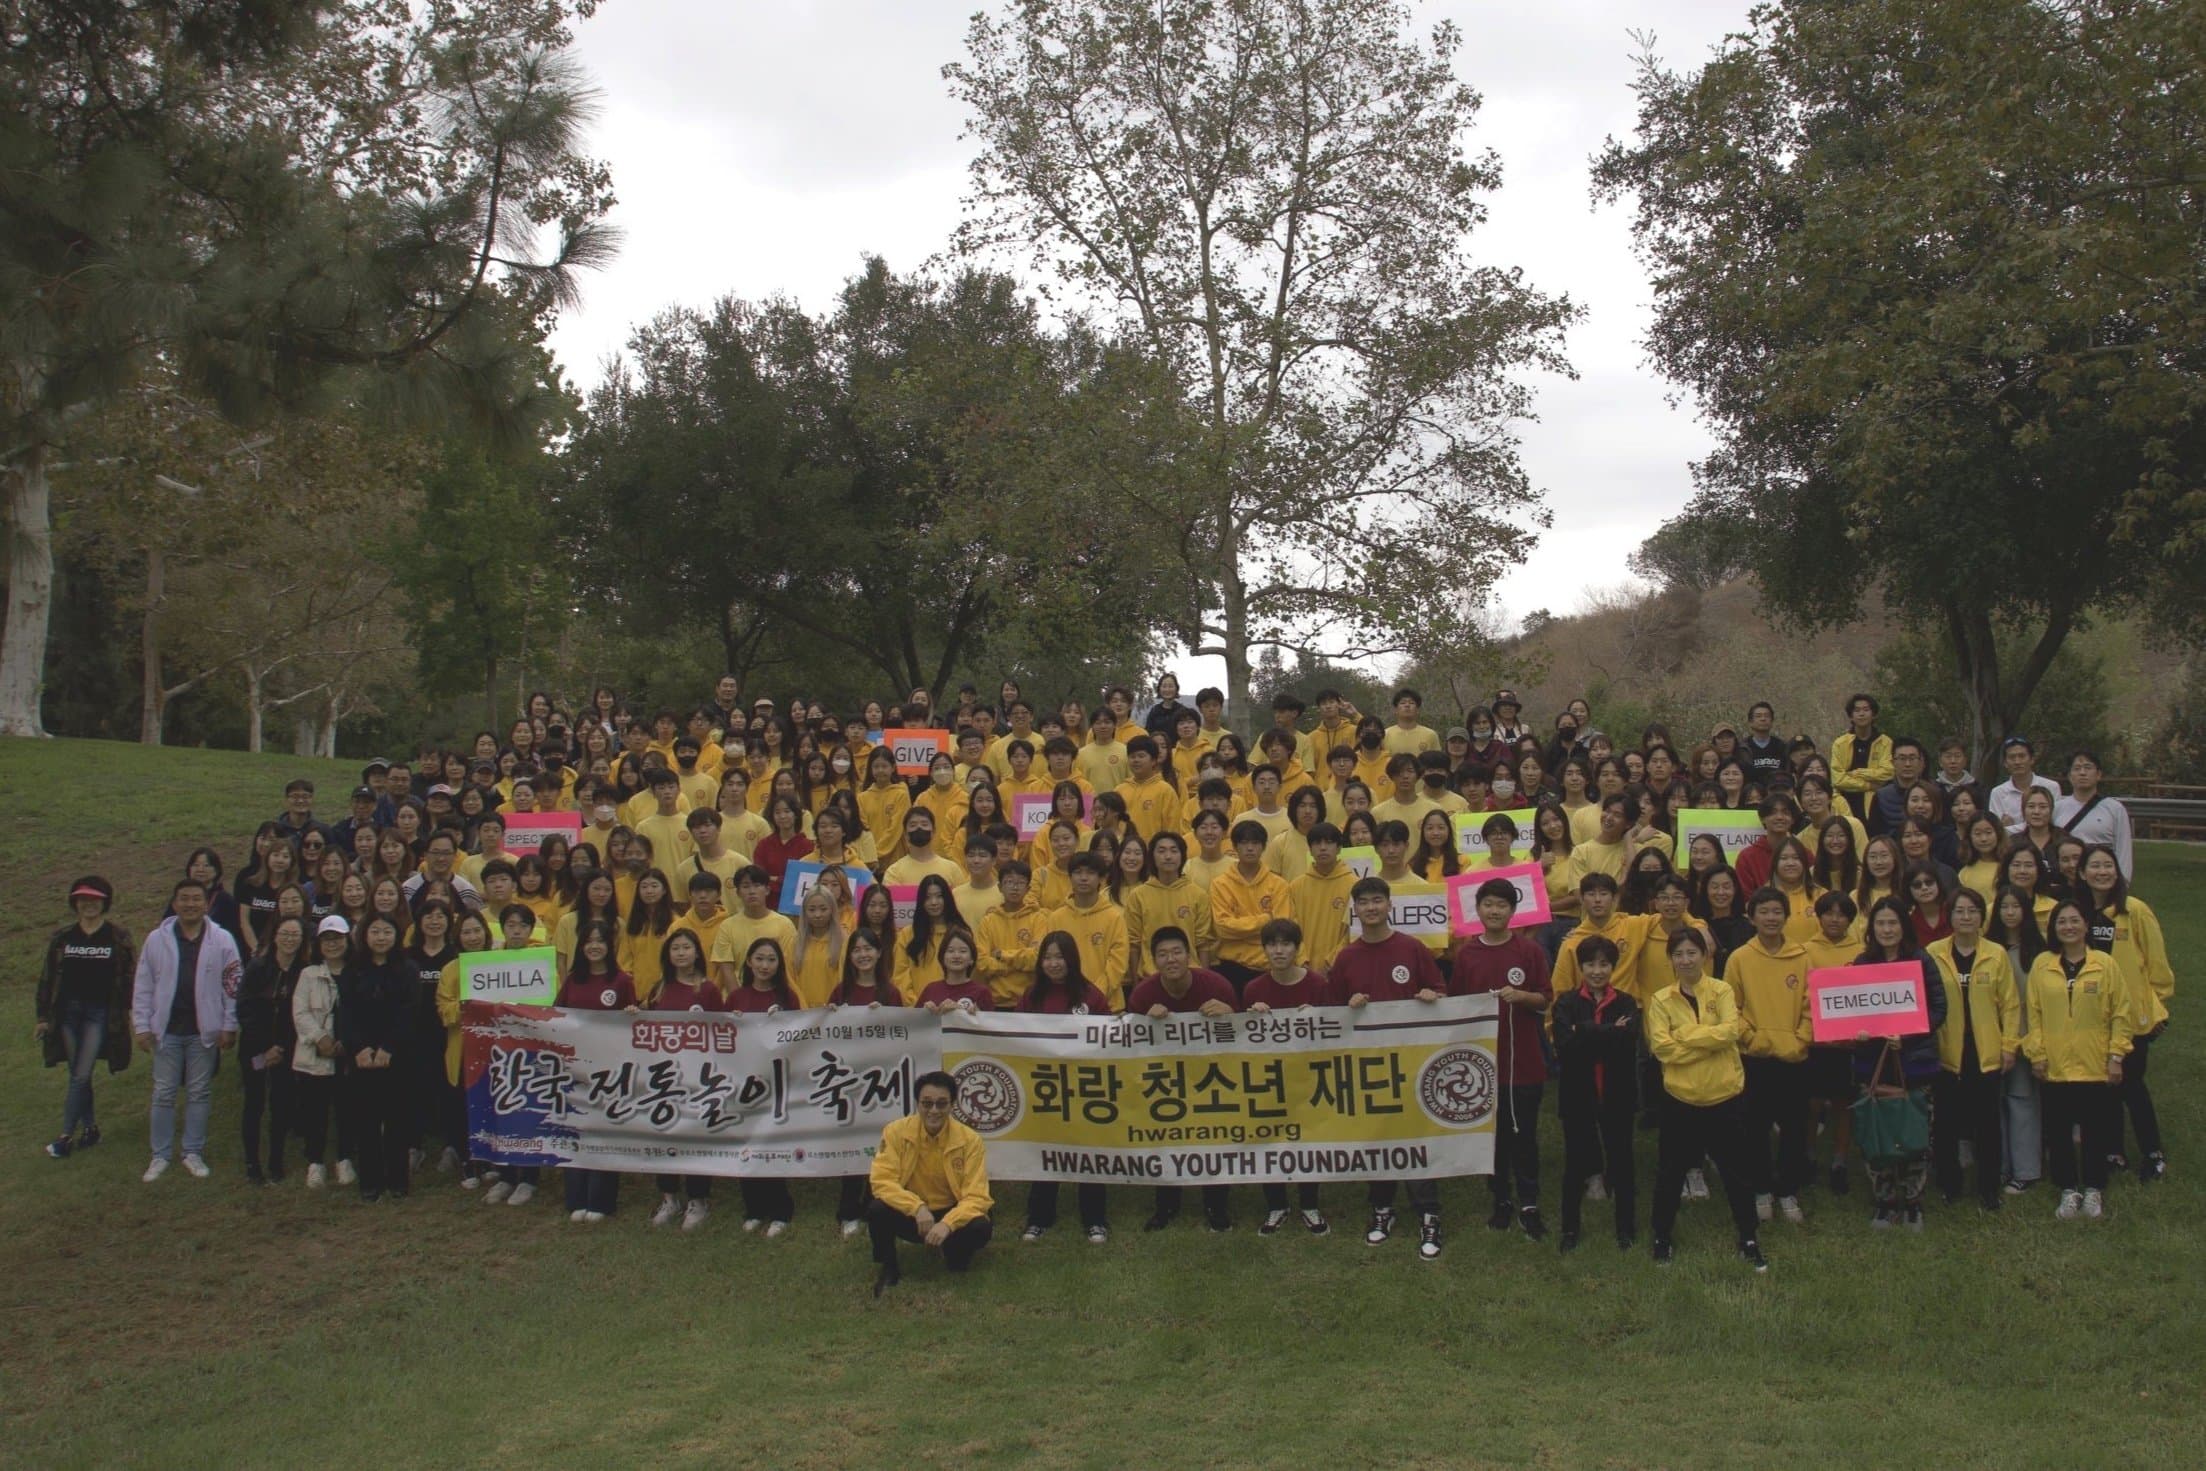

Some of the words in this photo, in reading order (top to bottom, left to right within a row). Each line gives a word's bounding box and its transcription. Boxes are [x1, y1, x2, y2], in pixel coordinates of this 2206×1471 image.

[896, 747, 935, 763] GIVE
[1350, 905, 1447, 926] HLERS
[473, 969, 544, 990] SHILLA
[1823, 990, 1914, 1010] TEMECULA
[634, 1023, 707, 1049] 화랑의
[714, 1025, 735, 1050] 날
[776, 1026, 822, 1043] 2022년
[826, 1025, 853, 1040] 10월
[857, 1025, 887, 1039] 15일
[889, 1025, 909, 1040] (토)
[1086, 1023, 1154, 1048] 미래의
[1165, 1021, 1236, 1045] 리더를
[1245, 1016, 1342, 1043] 양성하는
[960, 1064, 993, 1077] YOUTH
[1434, 1053, 1469, 1069] YOUTH
[489, 1046, 571, 1115] 한국
[810, 1051, 910, 1121] 축제
[1031, 1064, 1123, 1124] 화랑
[1142, 1059, 1287, 1122] 청소년
[1308, 1053, 1406, 1117] 재단
[1424, 1069, 1445, 1115] HWARANG
[1128, 1123, 1300, 1143] hwarang.org
[1041, 1150, 1163, 1177] HWARANG
[1171, 1151, 1256, 1177] YOUTH
[1265, 1145, 1428, 1174] FOUNDATION
